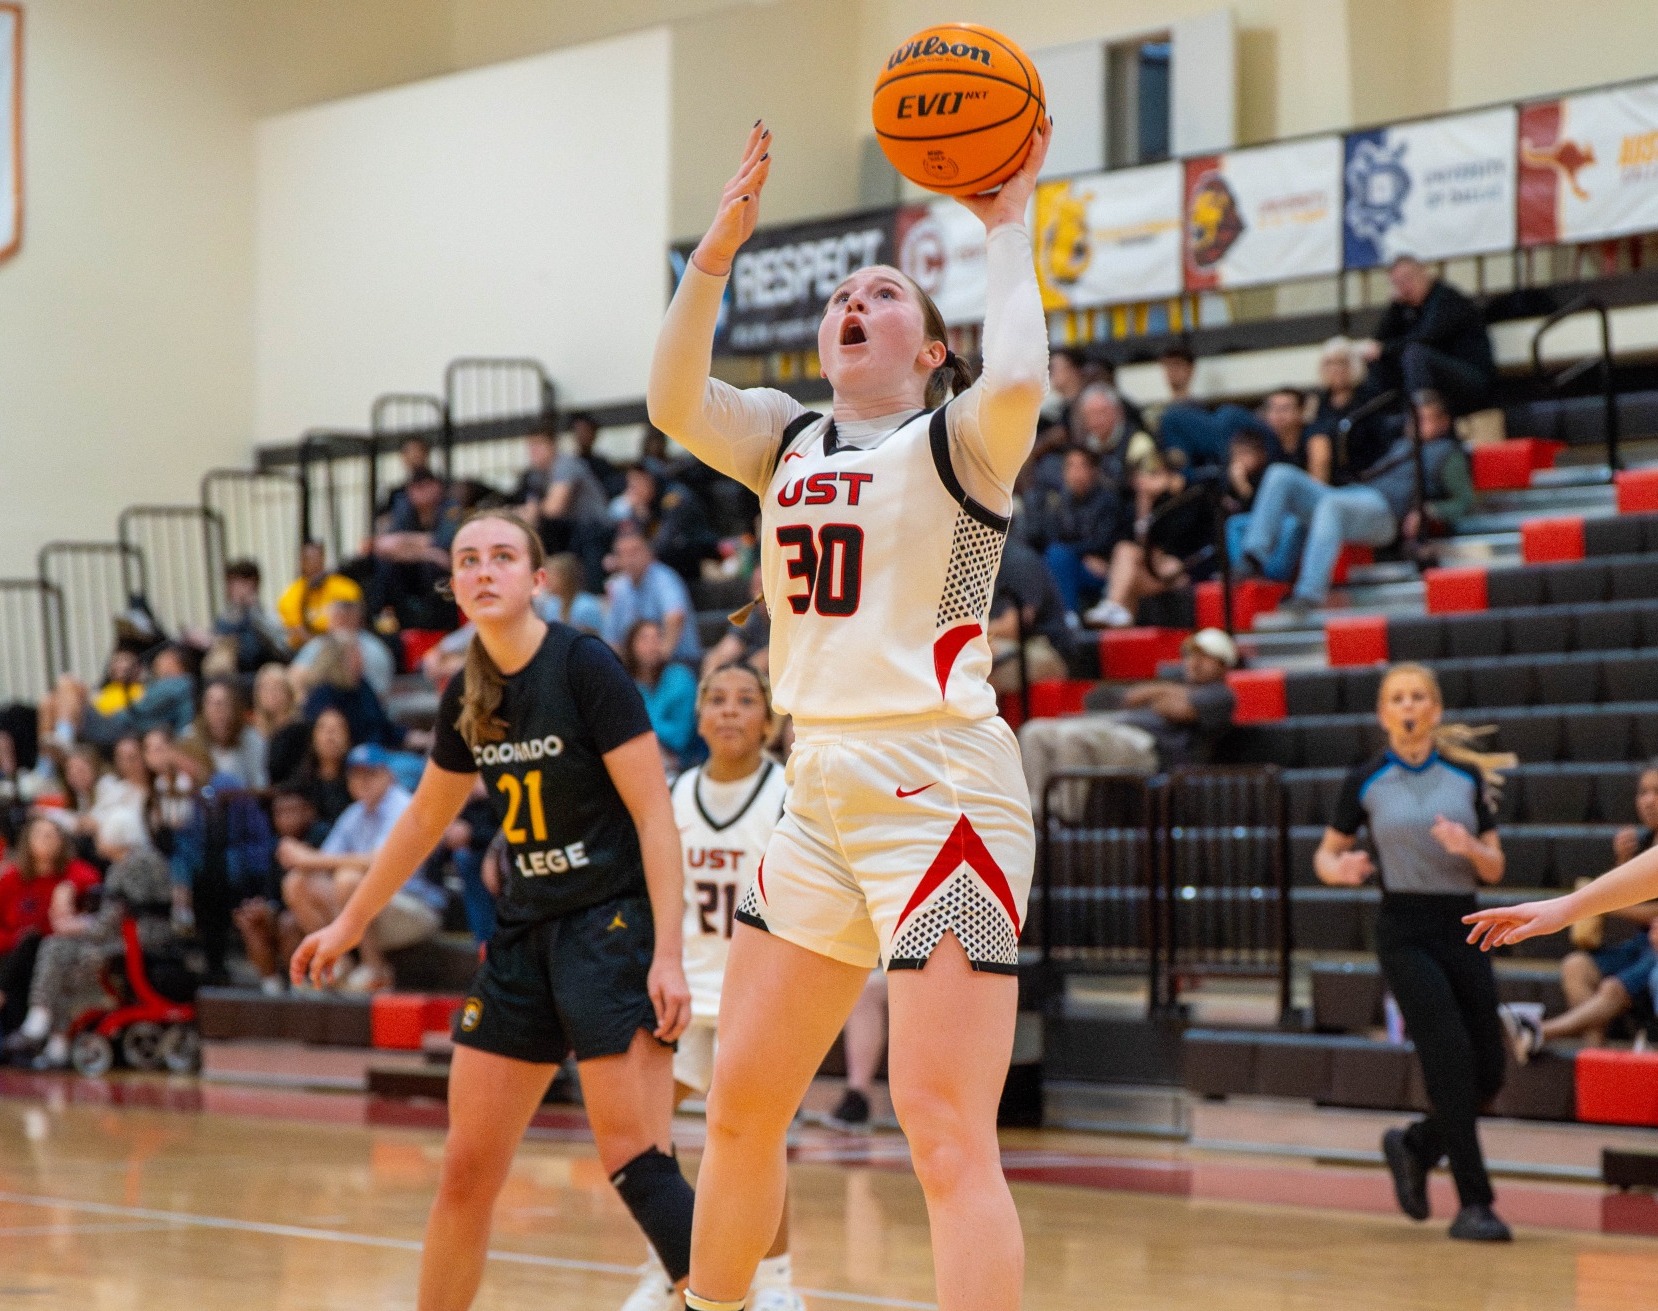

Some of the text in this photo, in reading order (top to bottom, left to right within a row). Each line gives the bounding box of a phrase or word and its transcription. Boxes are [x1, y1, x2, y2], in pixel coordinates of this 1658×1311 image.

[887, 36, 991, 71] Wilson
[897, 90, 989, 119] EVO NXT
[732, 228, 884, 313] RESPECT
[777, 471, 873, 507] UST
[776, 523, 865, 617] 30
[496, 769, 548, 844] 21
[687, 847, 746, 872] UST
[695, 881, 737, 939] 21
